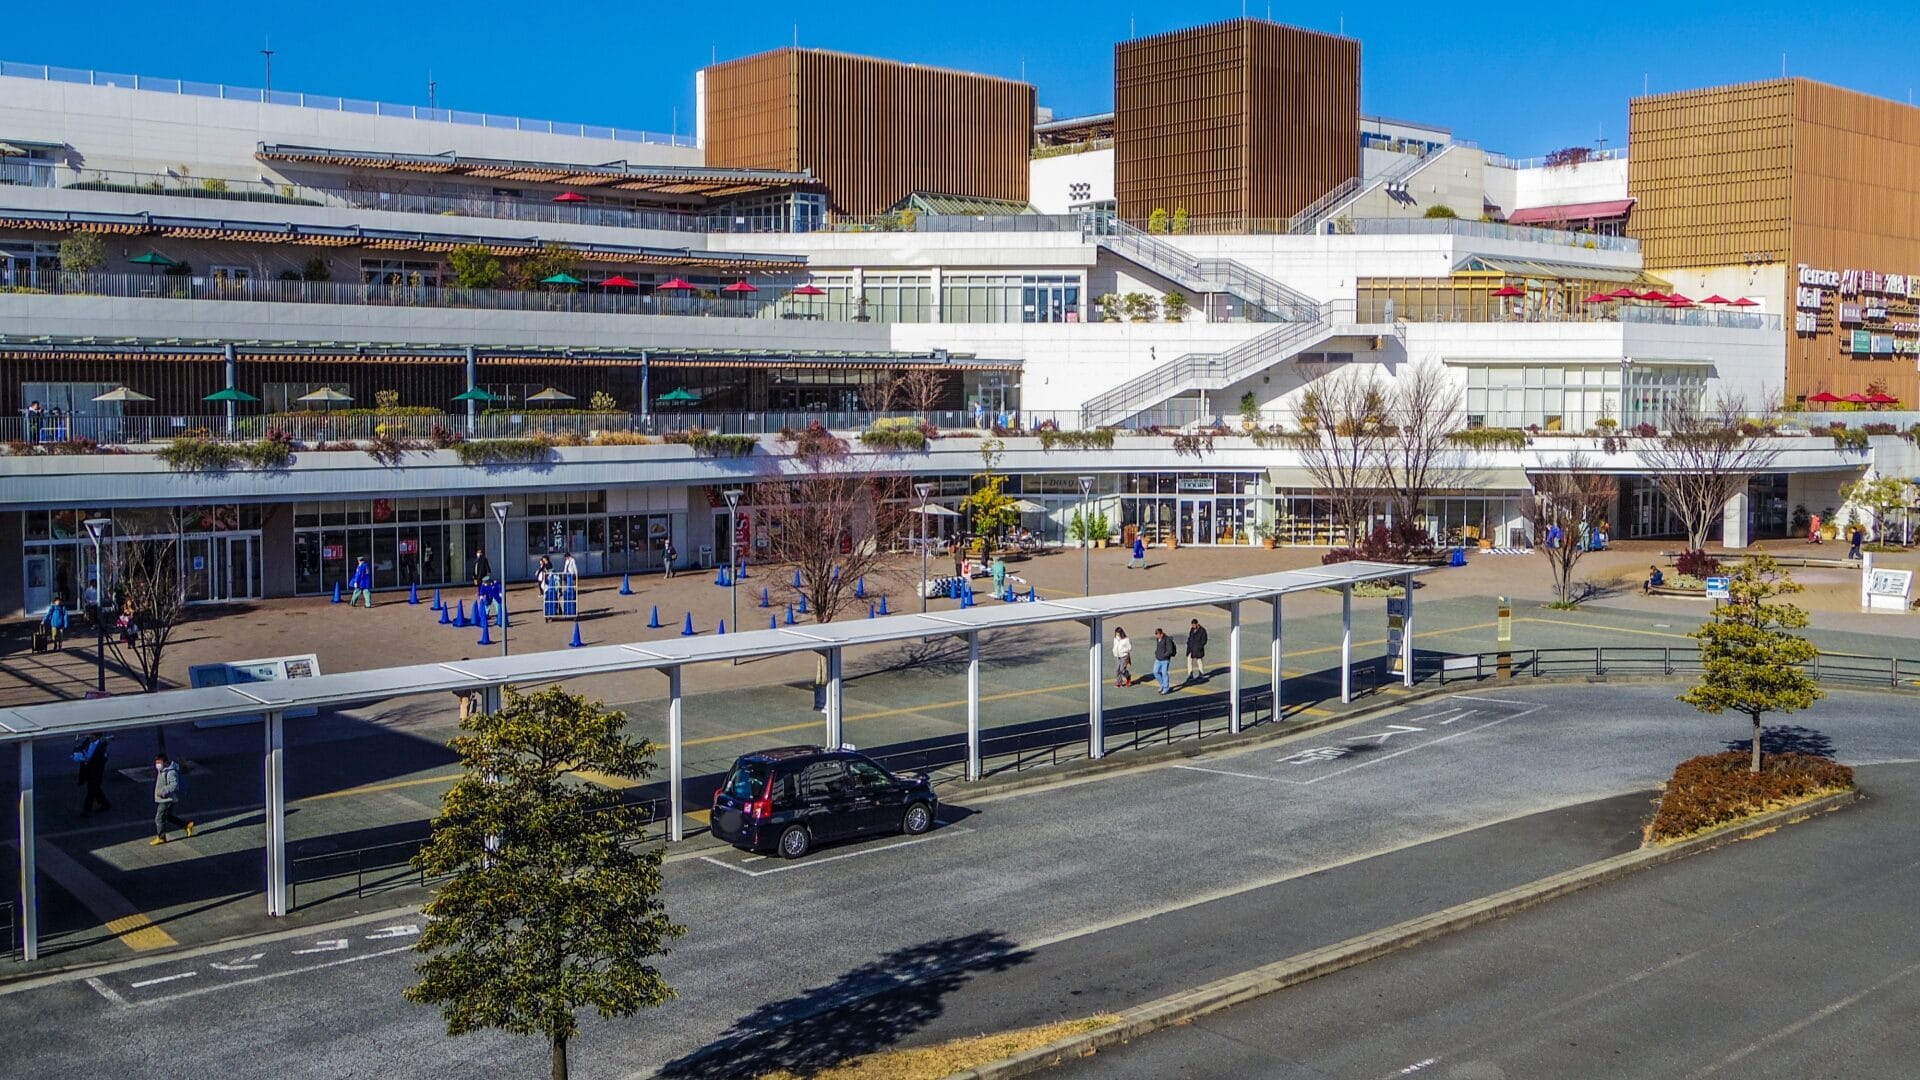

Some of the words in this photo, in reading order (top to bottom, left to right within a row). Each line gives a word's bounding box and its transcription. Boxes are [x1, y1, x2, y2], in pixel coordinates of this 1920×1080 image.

[1798, 264, 1839, 287] Terrace
[1797, 287, 1821, 307] Mall
[131, 924, 421, 988] タクシー
